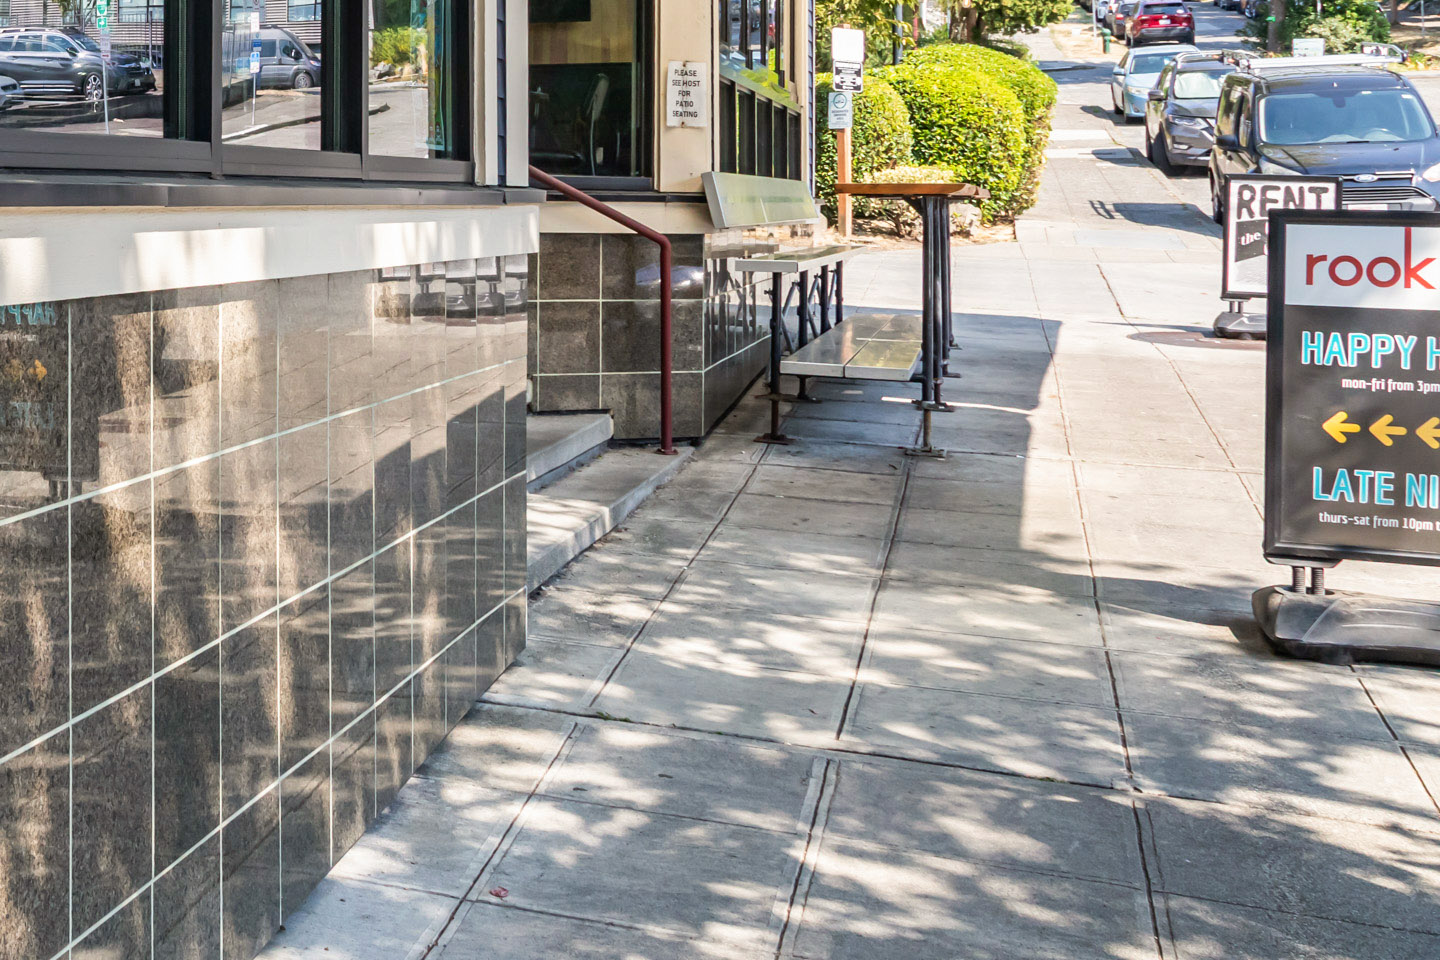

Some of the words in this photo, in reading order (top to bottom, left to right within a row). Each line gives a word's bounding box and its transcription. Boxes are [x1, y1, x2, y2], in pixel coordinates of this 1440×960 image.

[674, 69, 697, 77] PLEASE
[672, 79, 681, 87] SEE
[672, 110, 698, 118] SEATING
[1239, 231, 1262, 246] the
[1301, 330, 1418, 370] HAPPY
[1341, 378, 1386, 392] mon-fri
[1387, 379, 1414, 393] from
[1417, 380, 1440, 395] 3pm
[1312, 466, 1395, 506] LATE
[1318, 512, 1371, 526] thurs-sat
[1373, 515, 1399, 529] from
[1402, 517, 1434, 532] 10pm
